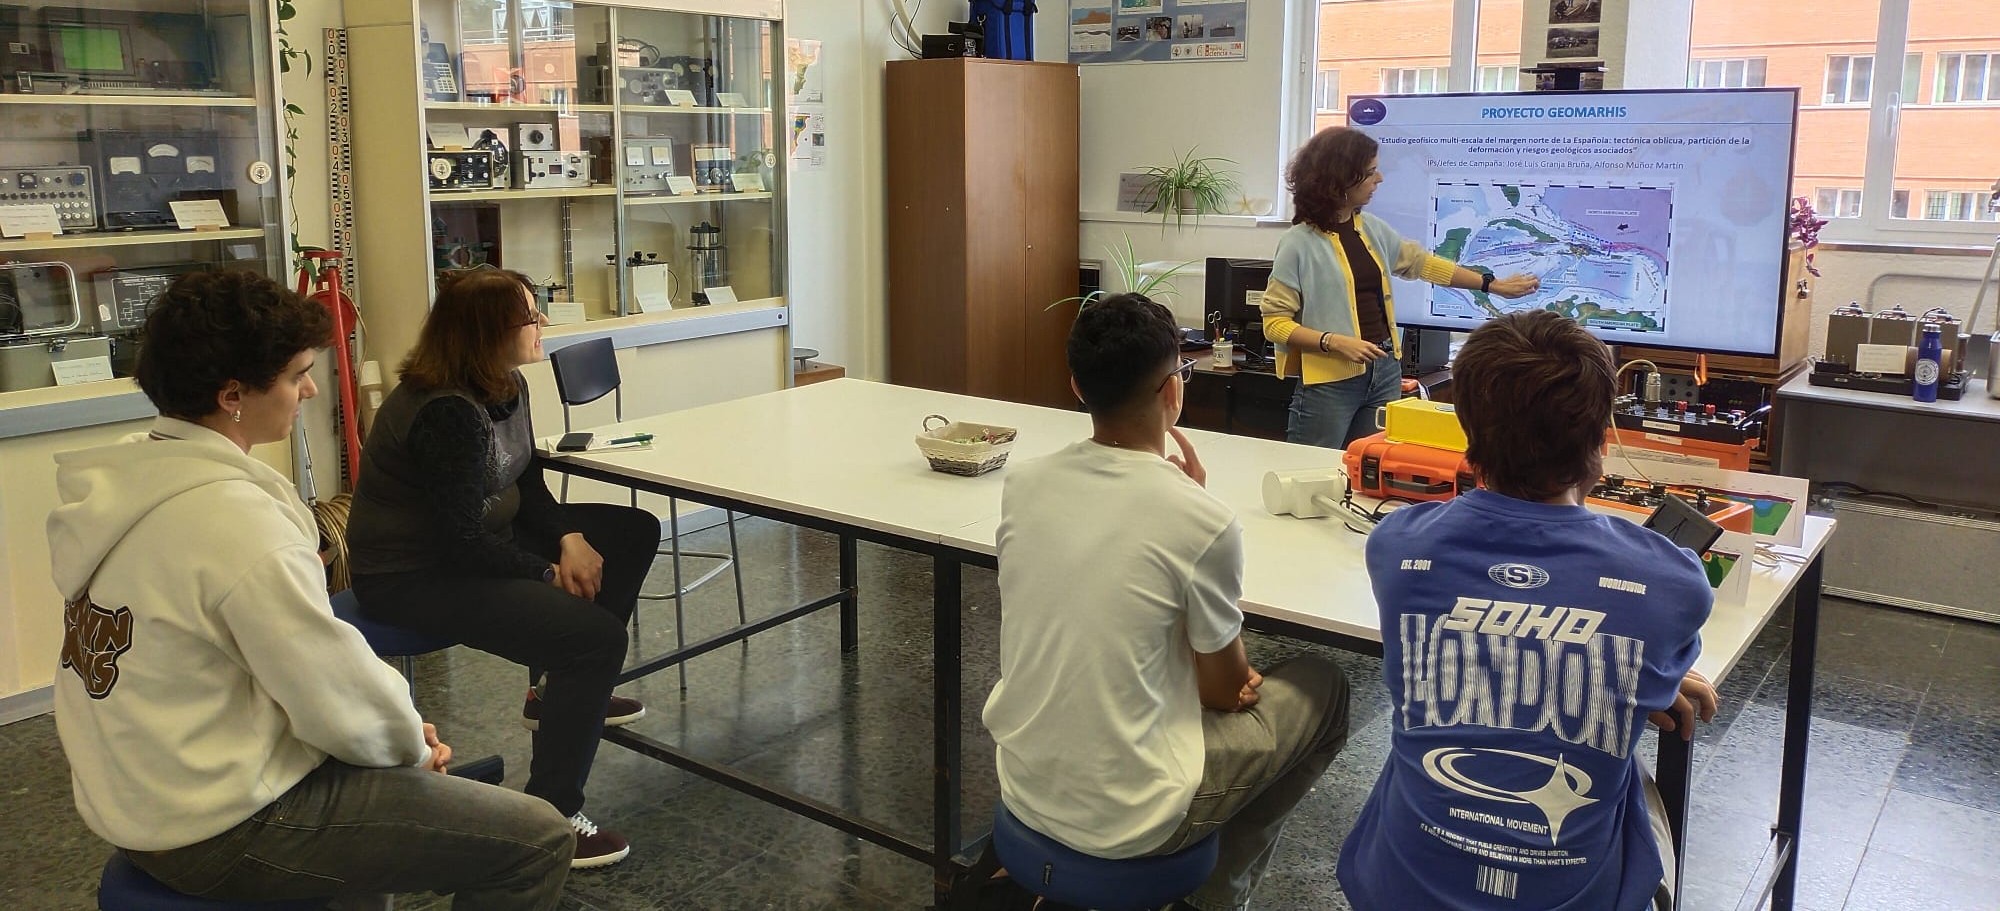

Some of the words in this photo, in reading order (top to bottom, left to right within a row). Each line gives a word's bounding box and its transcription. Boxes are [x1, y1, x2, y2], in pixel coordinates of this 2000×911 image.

[1481, 107, 1545, 119] PROYECTO
[1547, 106, 1627, 119] GEOMARHIS
[1440, 136, 1484, 145] multi-escala
[1485, 136, 1497, 145] del
[1498, 138, 1527, 146] margen
[1551, 136, 1561, 145] de
[1563, 137, 1572, 145] La
[1573, 137, 1612, 146] Española:
[1613, 136, 1651, 145] tectónica
[1653, 136, 1686, 146] oblicua,
[1688, 137, 1726, 147] partición
[1728, 137, 1740, 145] de
[1468, 146, 1515, 154] deformación
[1516, 147, 1521, 155] y
[1522, 147, 1549, 155] riesgos
[1550, 146, 1592, 156] geológicos
[1427, 159, 1457, 168] IPs/Jefes
[1458, 159, 1468, 167] de
[1469, 159, 1505, 169] Campaña:
[1507, 159, 1523, 168] José
[1524, 160, 1539, 168] Luis
[1540, 160, 1566, 170] Granja
[1594, 160, 1624, 170] Alfonso
[1626, 161, 1654, 169] Muñoz
[1655, 161, 1684, 170] Martín
[1400, 559, 1413, 570] EST.
[1413, 560, 1432, 571] 2001
[1599, 576, 1647, 595] WORLDWIDE
[1443, 596, 1607, 645] SOHO
[1400, 613, 1645, 760] LONDON
[1449, 807, 1505, 827] INTERNATIONAL
[1506, 817, 1549, 835] MOVEMENT
[1478, 848, 1489, 857] AND
[1513, 855, 1518, 863] IN
[1533, 858, 1547, 866] THAN
